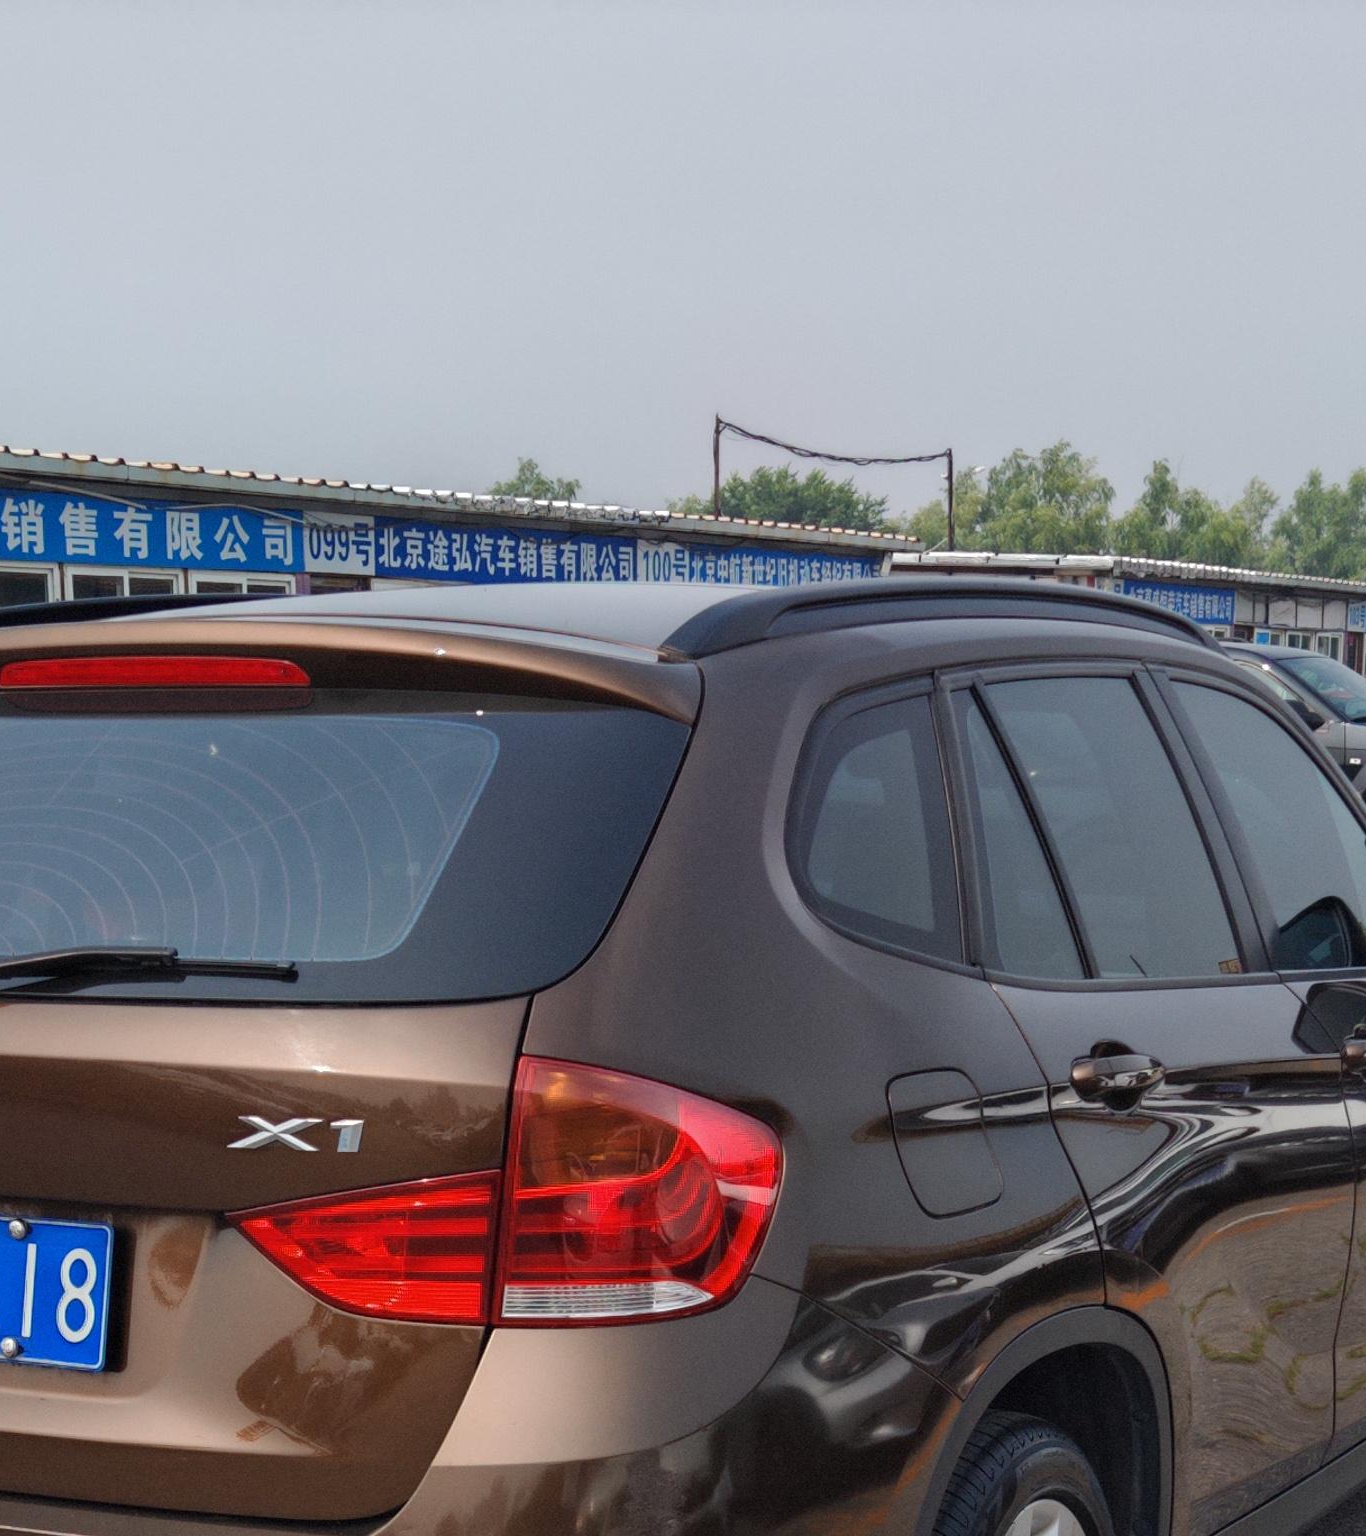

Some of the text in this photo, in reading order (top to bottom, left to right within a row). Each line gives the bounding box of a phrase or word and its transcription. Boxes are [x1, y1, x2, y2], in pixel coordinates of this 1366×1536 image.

[308, 522, 372, 567] 099号
[642, 548, 688, 583] 100号
[227, 1115, 364, 1152] X1
